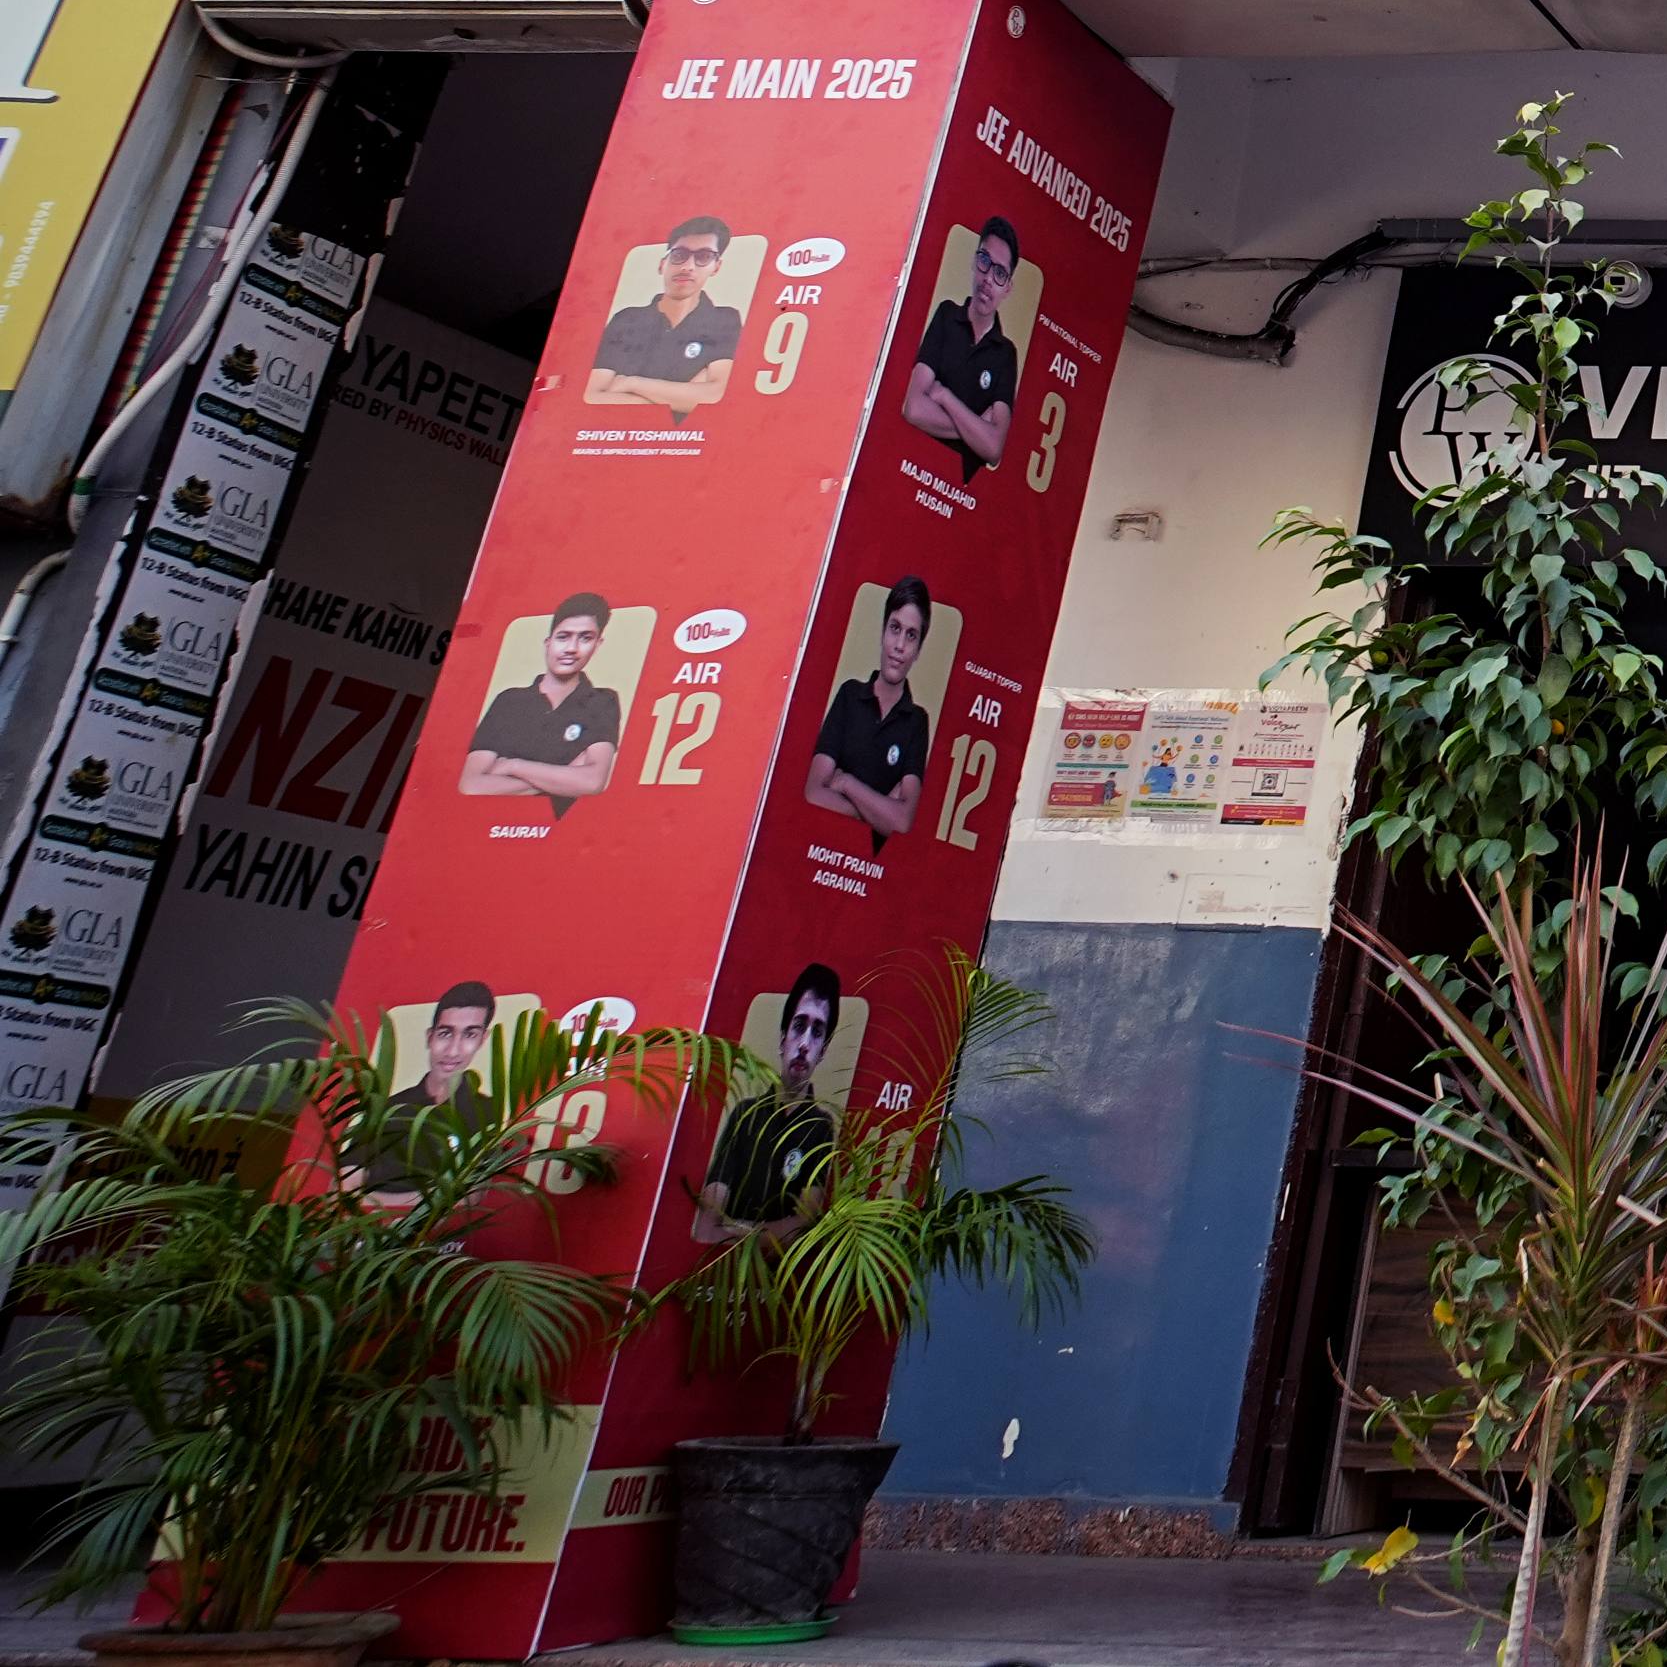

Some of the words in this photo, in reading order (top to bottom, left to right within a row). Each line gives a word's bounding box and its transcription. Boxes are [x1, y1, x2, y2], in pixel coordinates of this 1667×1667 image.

[662, 60, 723, 99] JEE
[726, 60, 821, 99] MAIN
[824, 60, 917, 99] 2025
[976, 107, 1010, 155] JEE
[1007, 130, 1092, 220] ADVANCED
[1092, 196, 1132, 252] 2025
[775, 286, 821, 305] AIR
[755, 312, 808, 394] 9
[1049, 352, 1078, 387] AIR
[266, 355, 313, 405] GLA
[395, 410, 467, 450] PHYSICS
[576, 430, 625, 441] SHIVEN
[627, 430, 705, 441] TOSHNIWAL
[1027, 392, 1065, 493] 3
[220, 481, 269, 528] GLA
[349, 605, 433, 664] KAHIN
[673, 663, 721, 684] AIR
[969, 694, 1001, 726] AIR
[639, 693, 721, 785] 12
[936, 735, 997, 850] 12
[489, 825, 550, 838] SAURAV
[183, 824, 330, 909] YAHIN
[808, 844, 842, 870] MOHIT
[844, 855, 884, 879] PRAVIN
[813, 871, 868, 897] AGRAWAL
